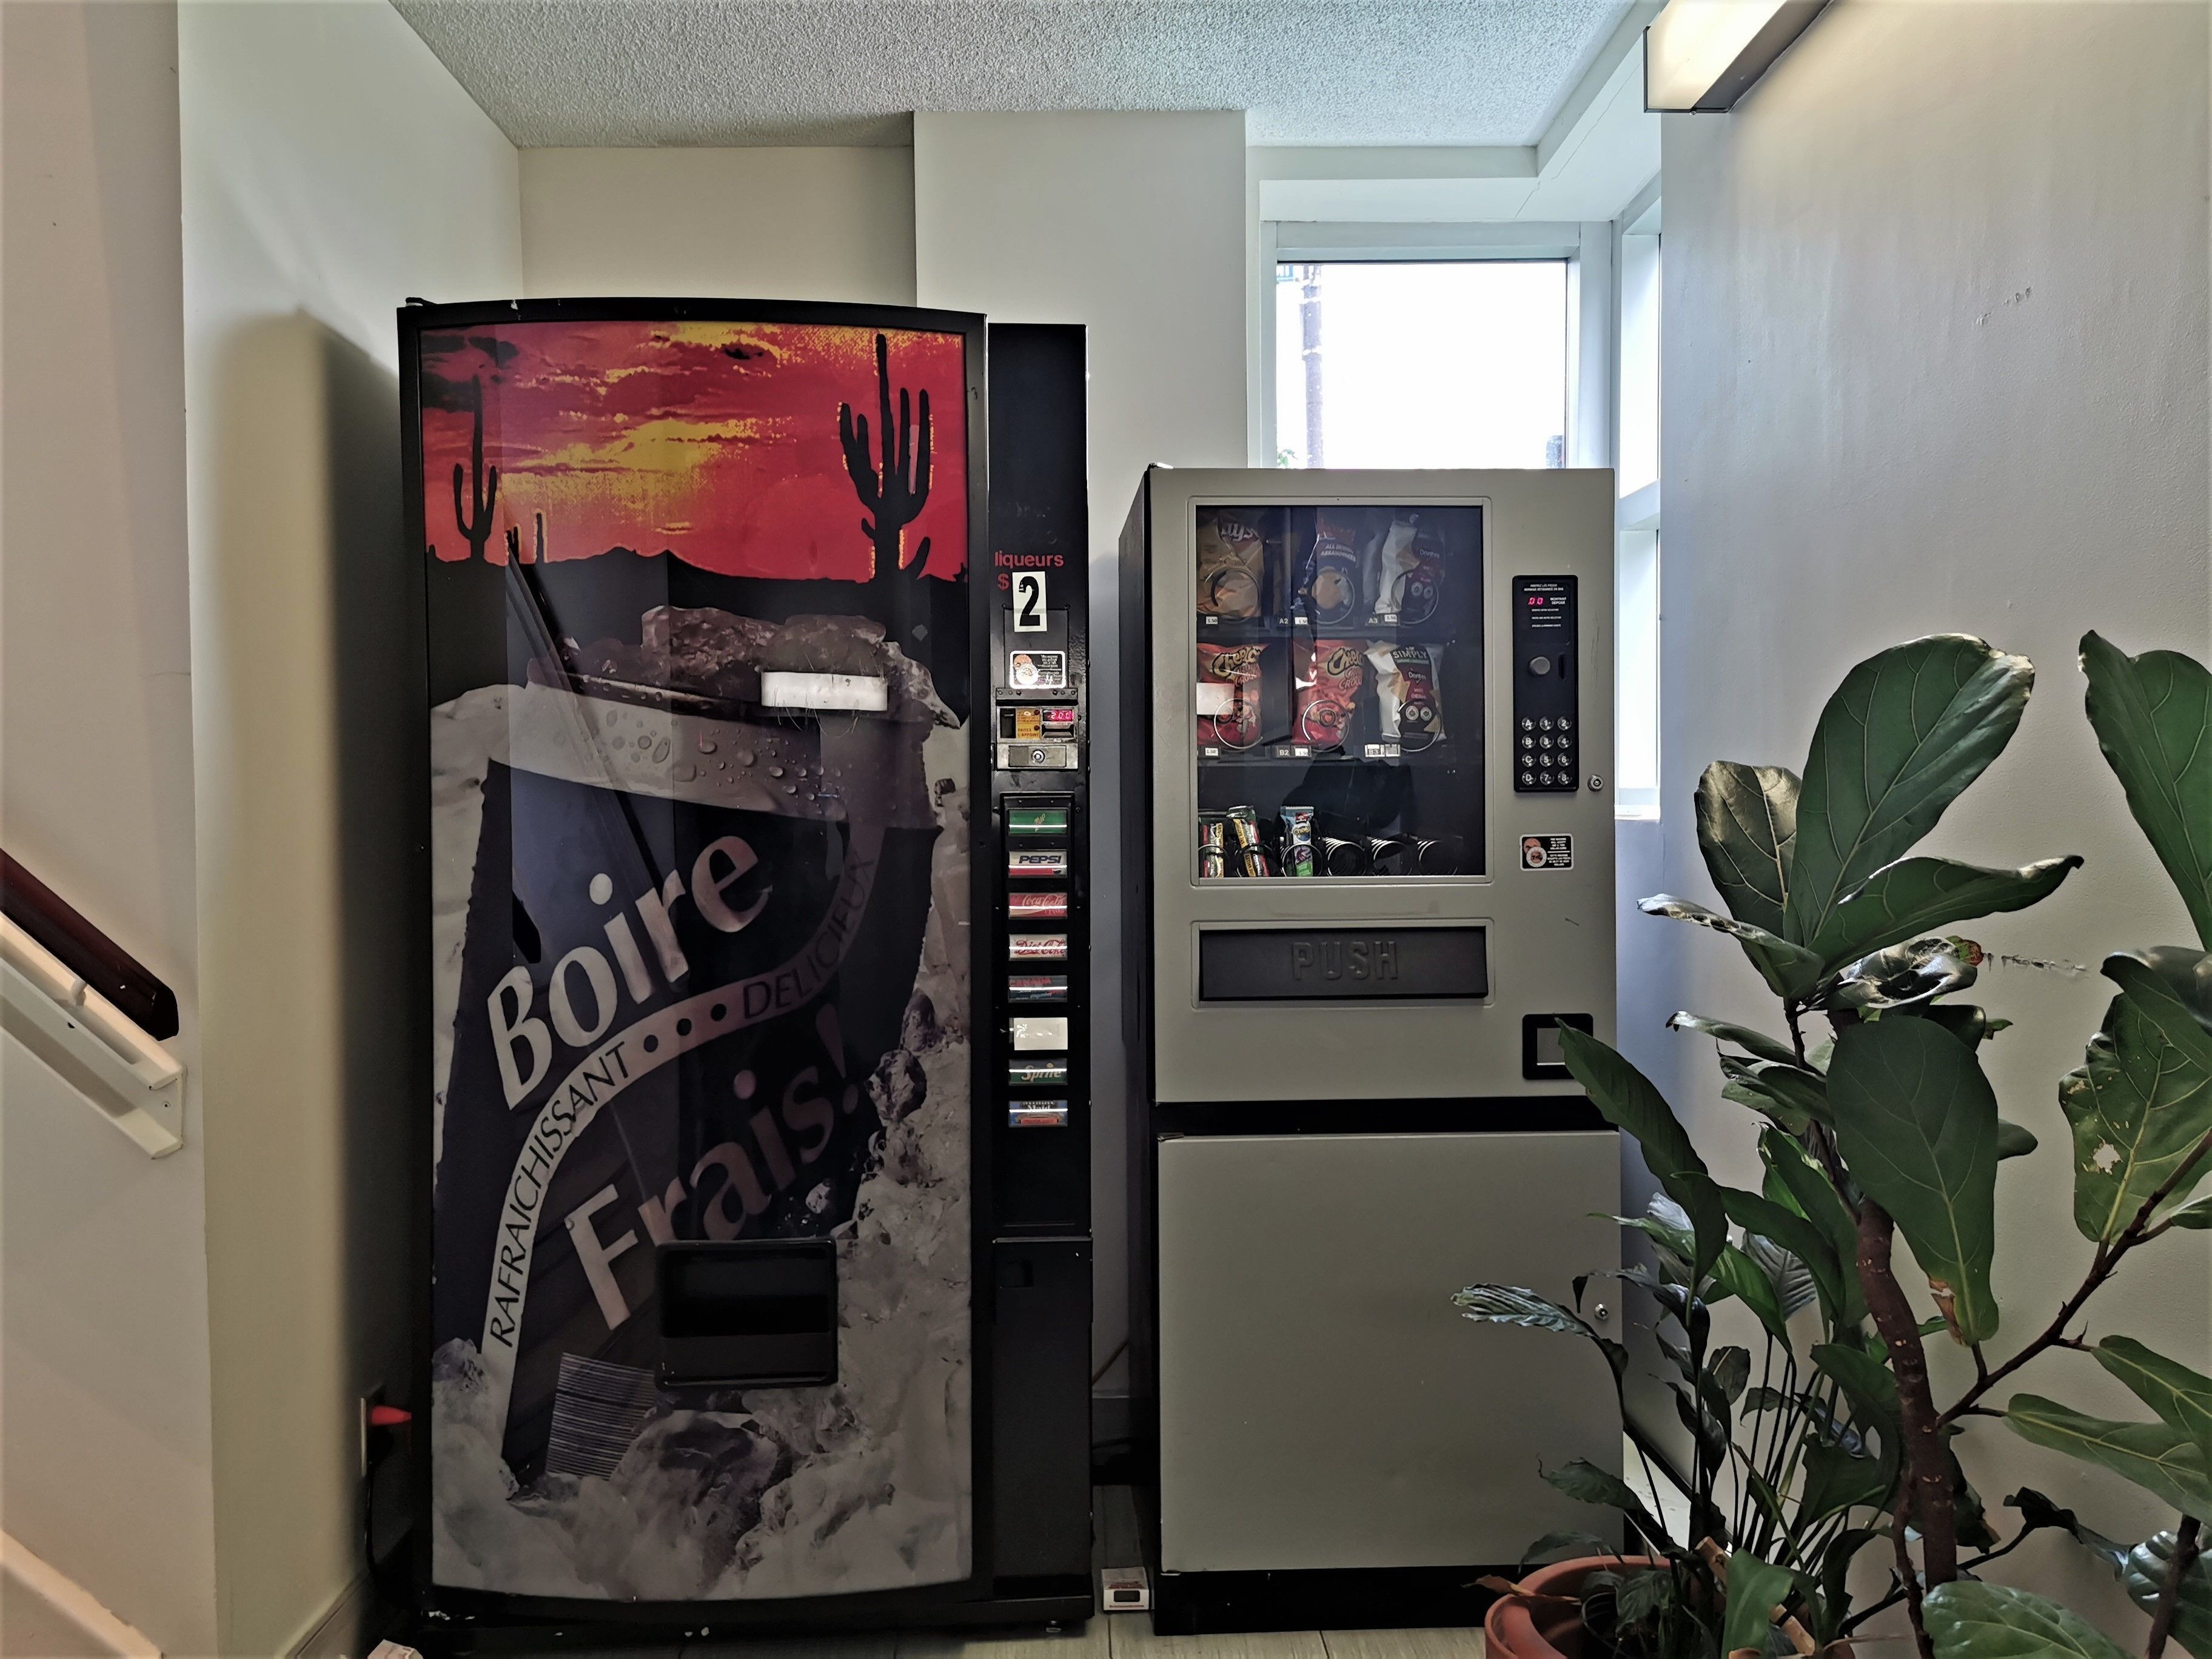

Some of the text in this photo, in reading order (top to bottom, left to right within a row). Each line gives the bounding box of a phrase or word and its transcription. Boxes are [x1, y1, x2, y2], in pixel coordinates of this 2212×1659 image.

[994, 549, 1064, 569] liqueurs
[997, 572, 1041, 626] $ 2
[1393, 650, 1427, 659] SIMPLY
[1525, 755, 1532, 763] C
[1019, 856, 1061, 864] PEPSI
[487, 836, 773, 1111] Boire
[1292, 941, 1398, 980] PUSH
[1021, 1062, 1061, 1082] Sprite
[490, 850, 874, 1347] RAFRAICHISSANT DELICIEUX
[564, 1004, 859, 1330] Frais!
